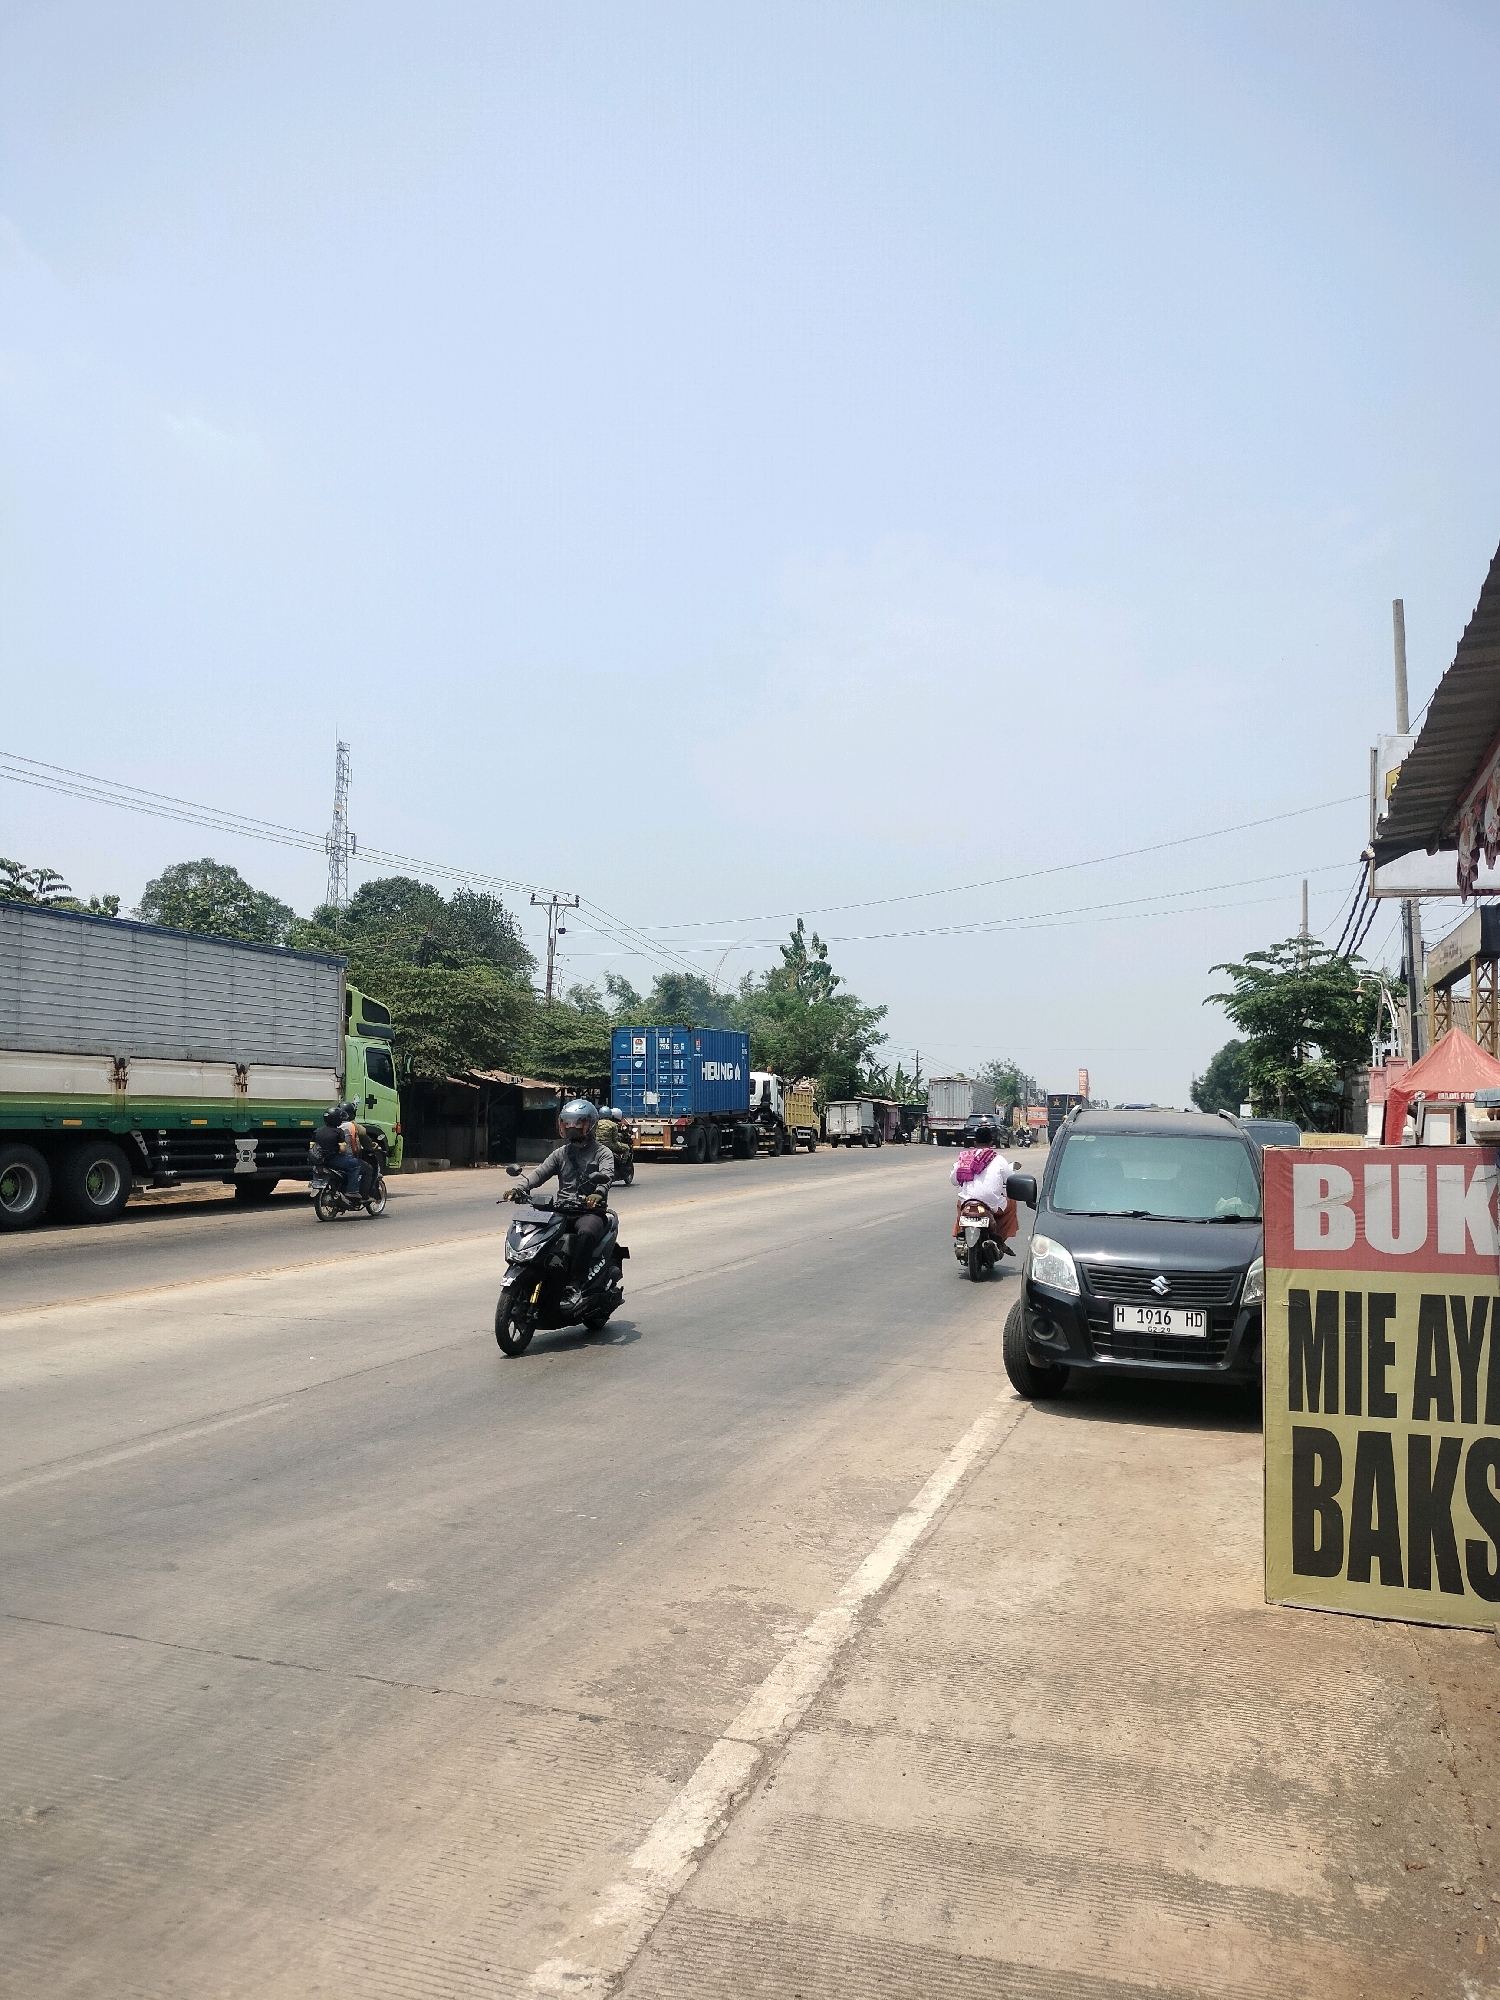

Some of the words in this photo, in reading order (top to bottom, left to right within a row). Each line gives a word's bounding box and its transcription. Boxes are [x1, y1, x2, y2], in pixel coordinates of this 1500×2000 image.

[1293, 1163, 1499, 1255] BUK
[1116, 1308, 1125, 1322] H
[1137, 1309, 1172, 1325] 1916
[1185, 1312, 1203, 1327] HD
[1288, 1288, 1398, 1418] MIE
[1291, 1426, 1500, 1603] BAKS
